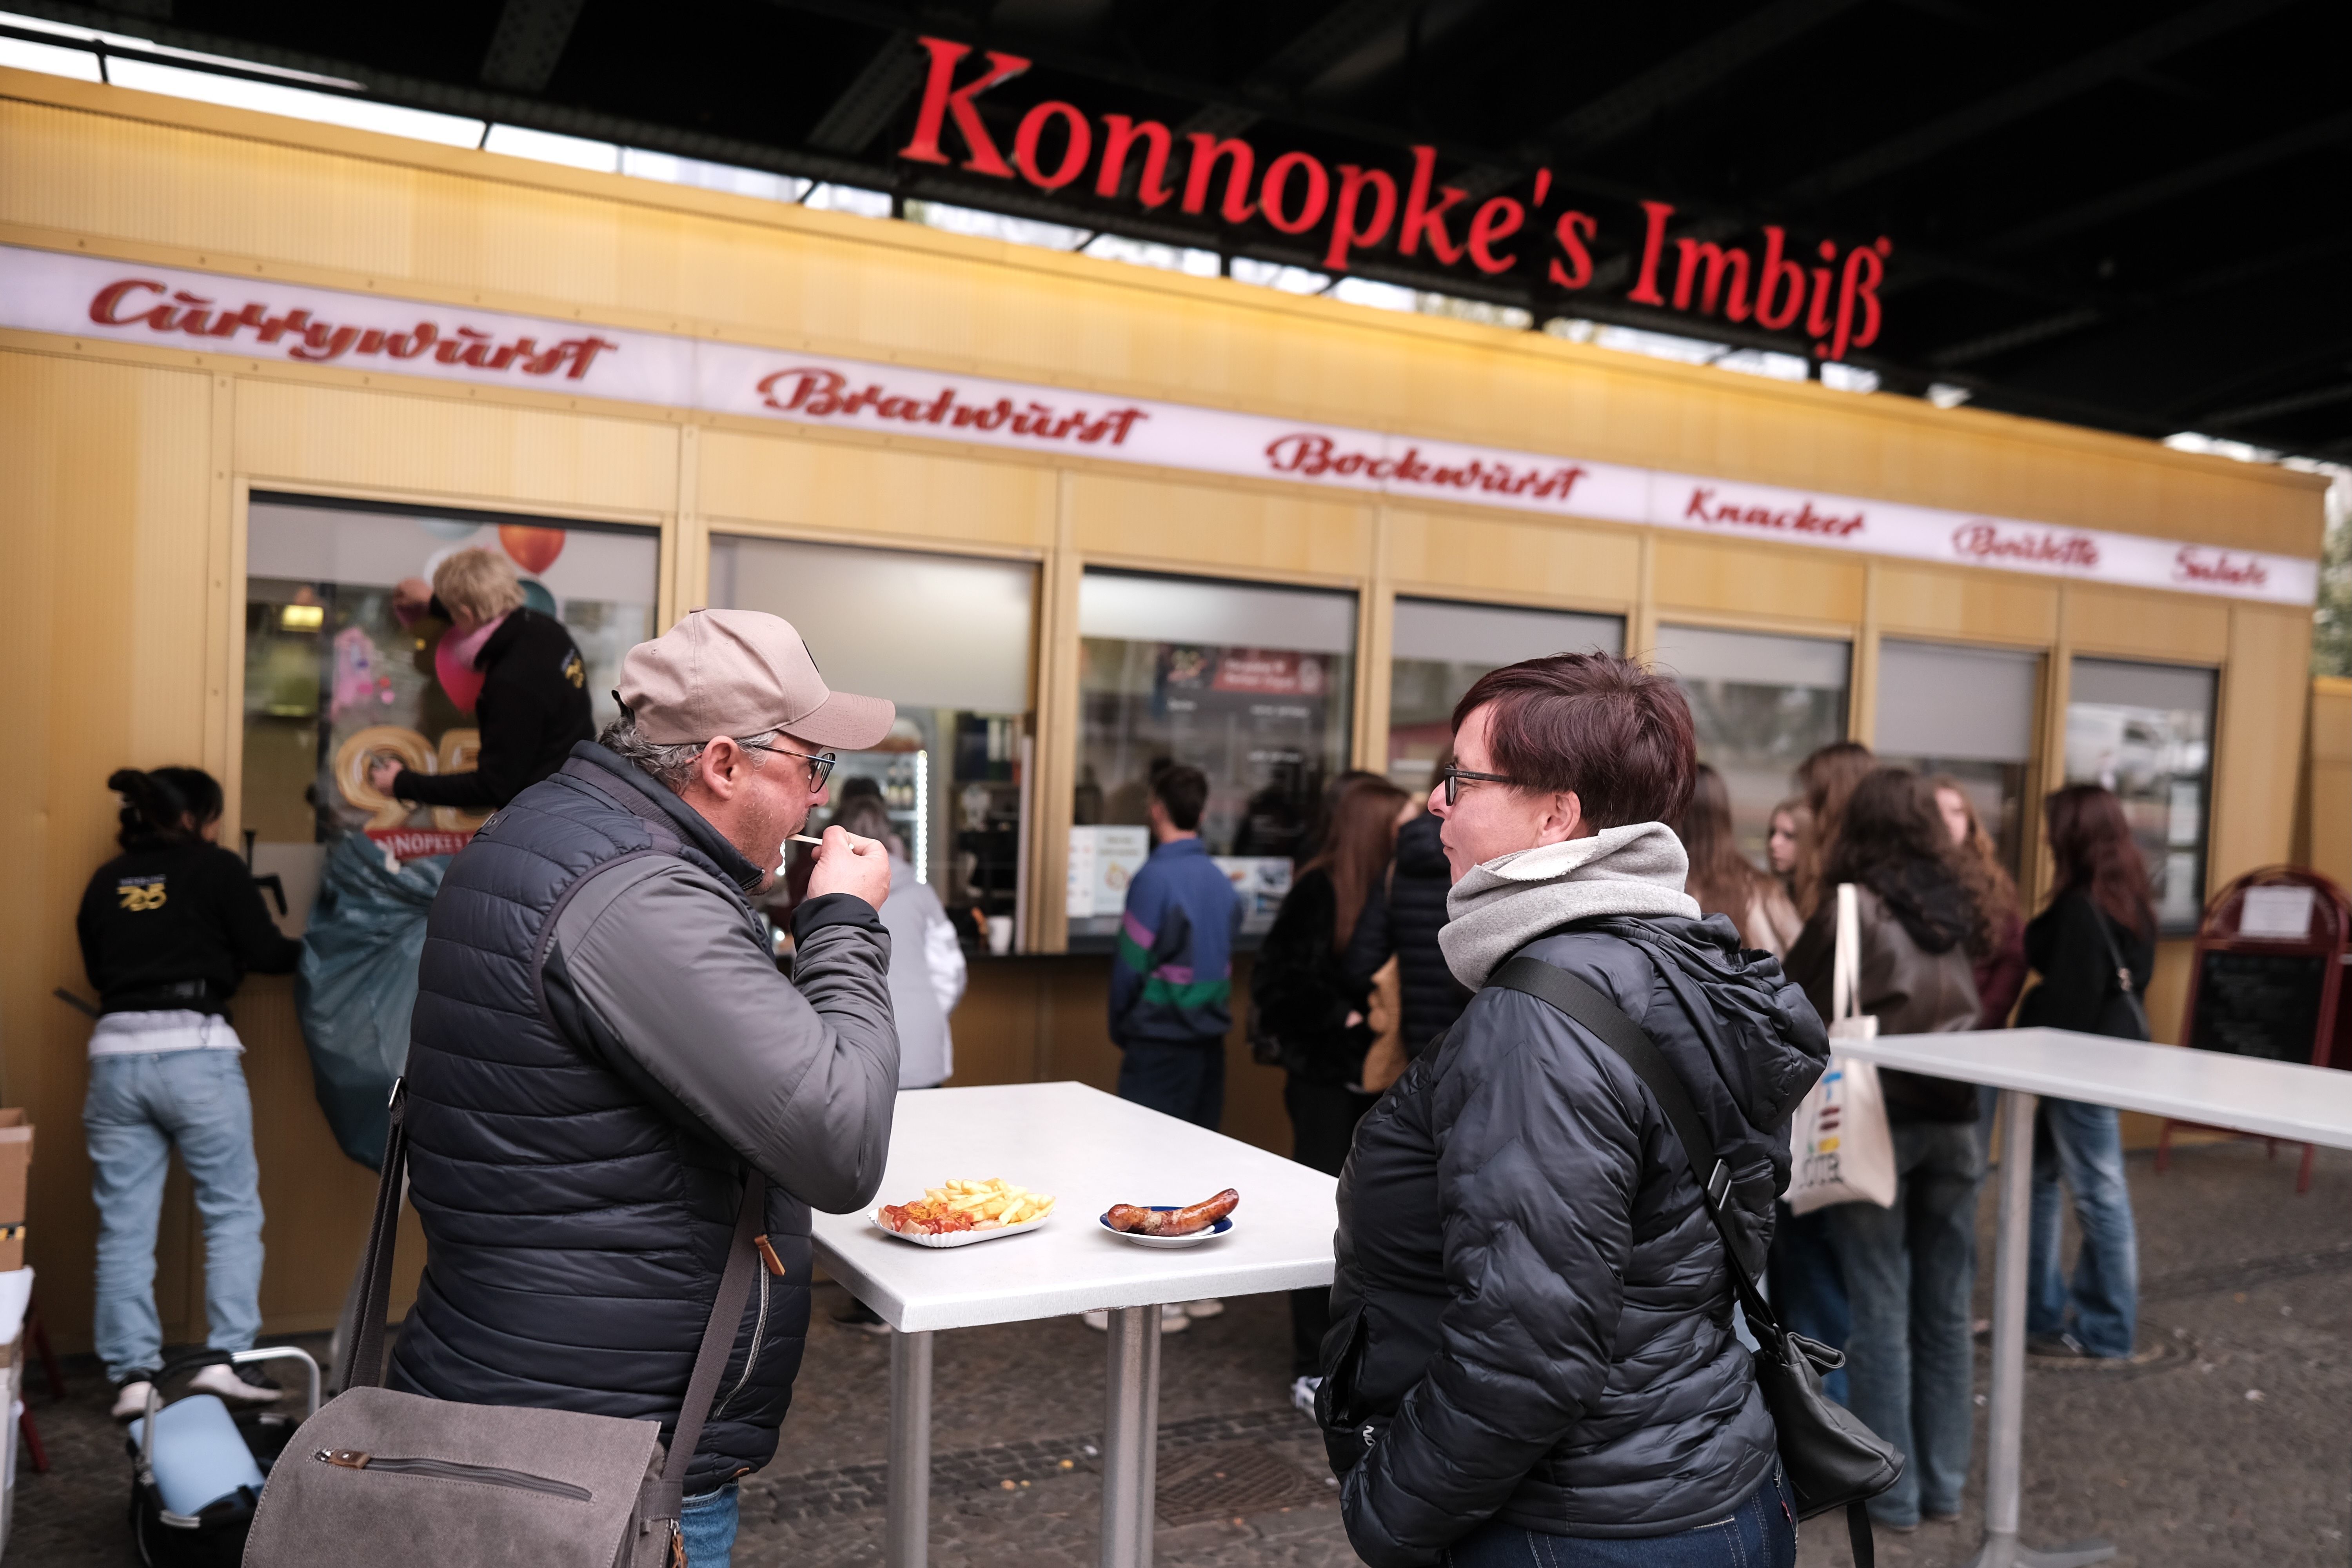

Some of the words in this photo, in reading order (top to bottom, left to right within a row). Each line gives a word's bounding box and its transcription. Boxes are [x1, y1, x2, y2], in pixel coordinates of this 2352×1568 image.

[901, 37, 1596, 289] Konnopke's
[1629, 202, 1890, 360] Imbiß
[1684, 487, 1864, 537] Knacker
